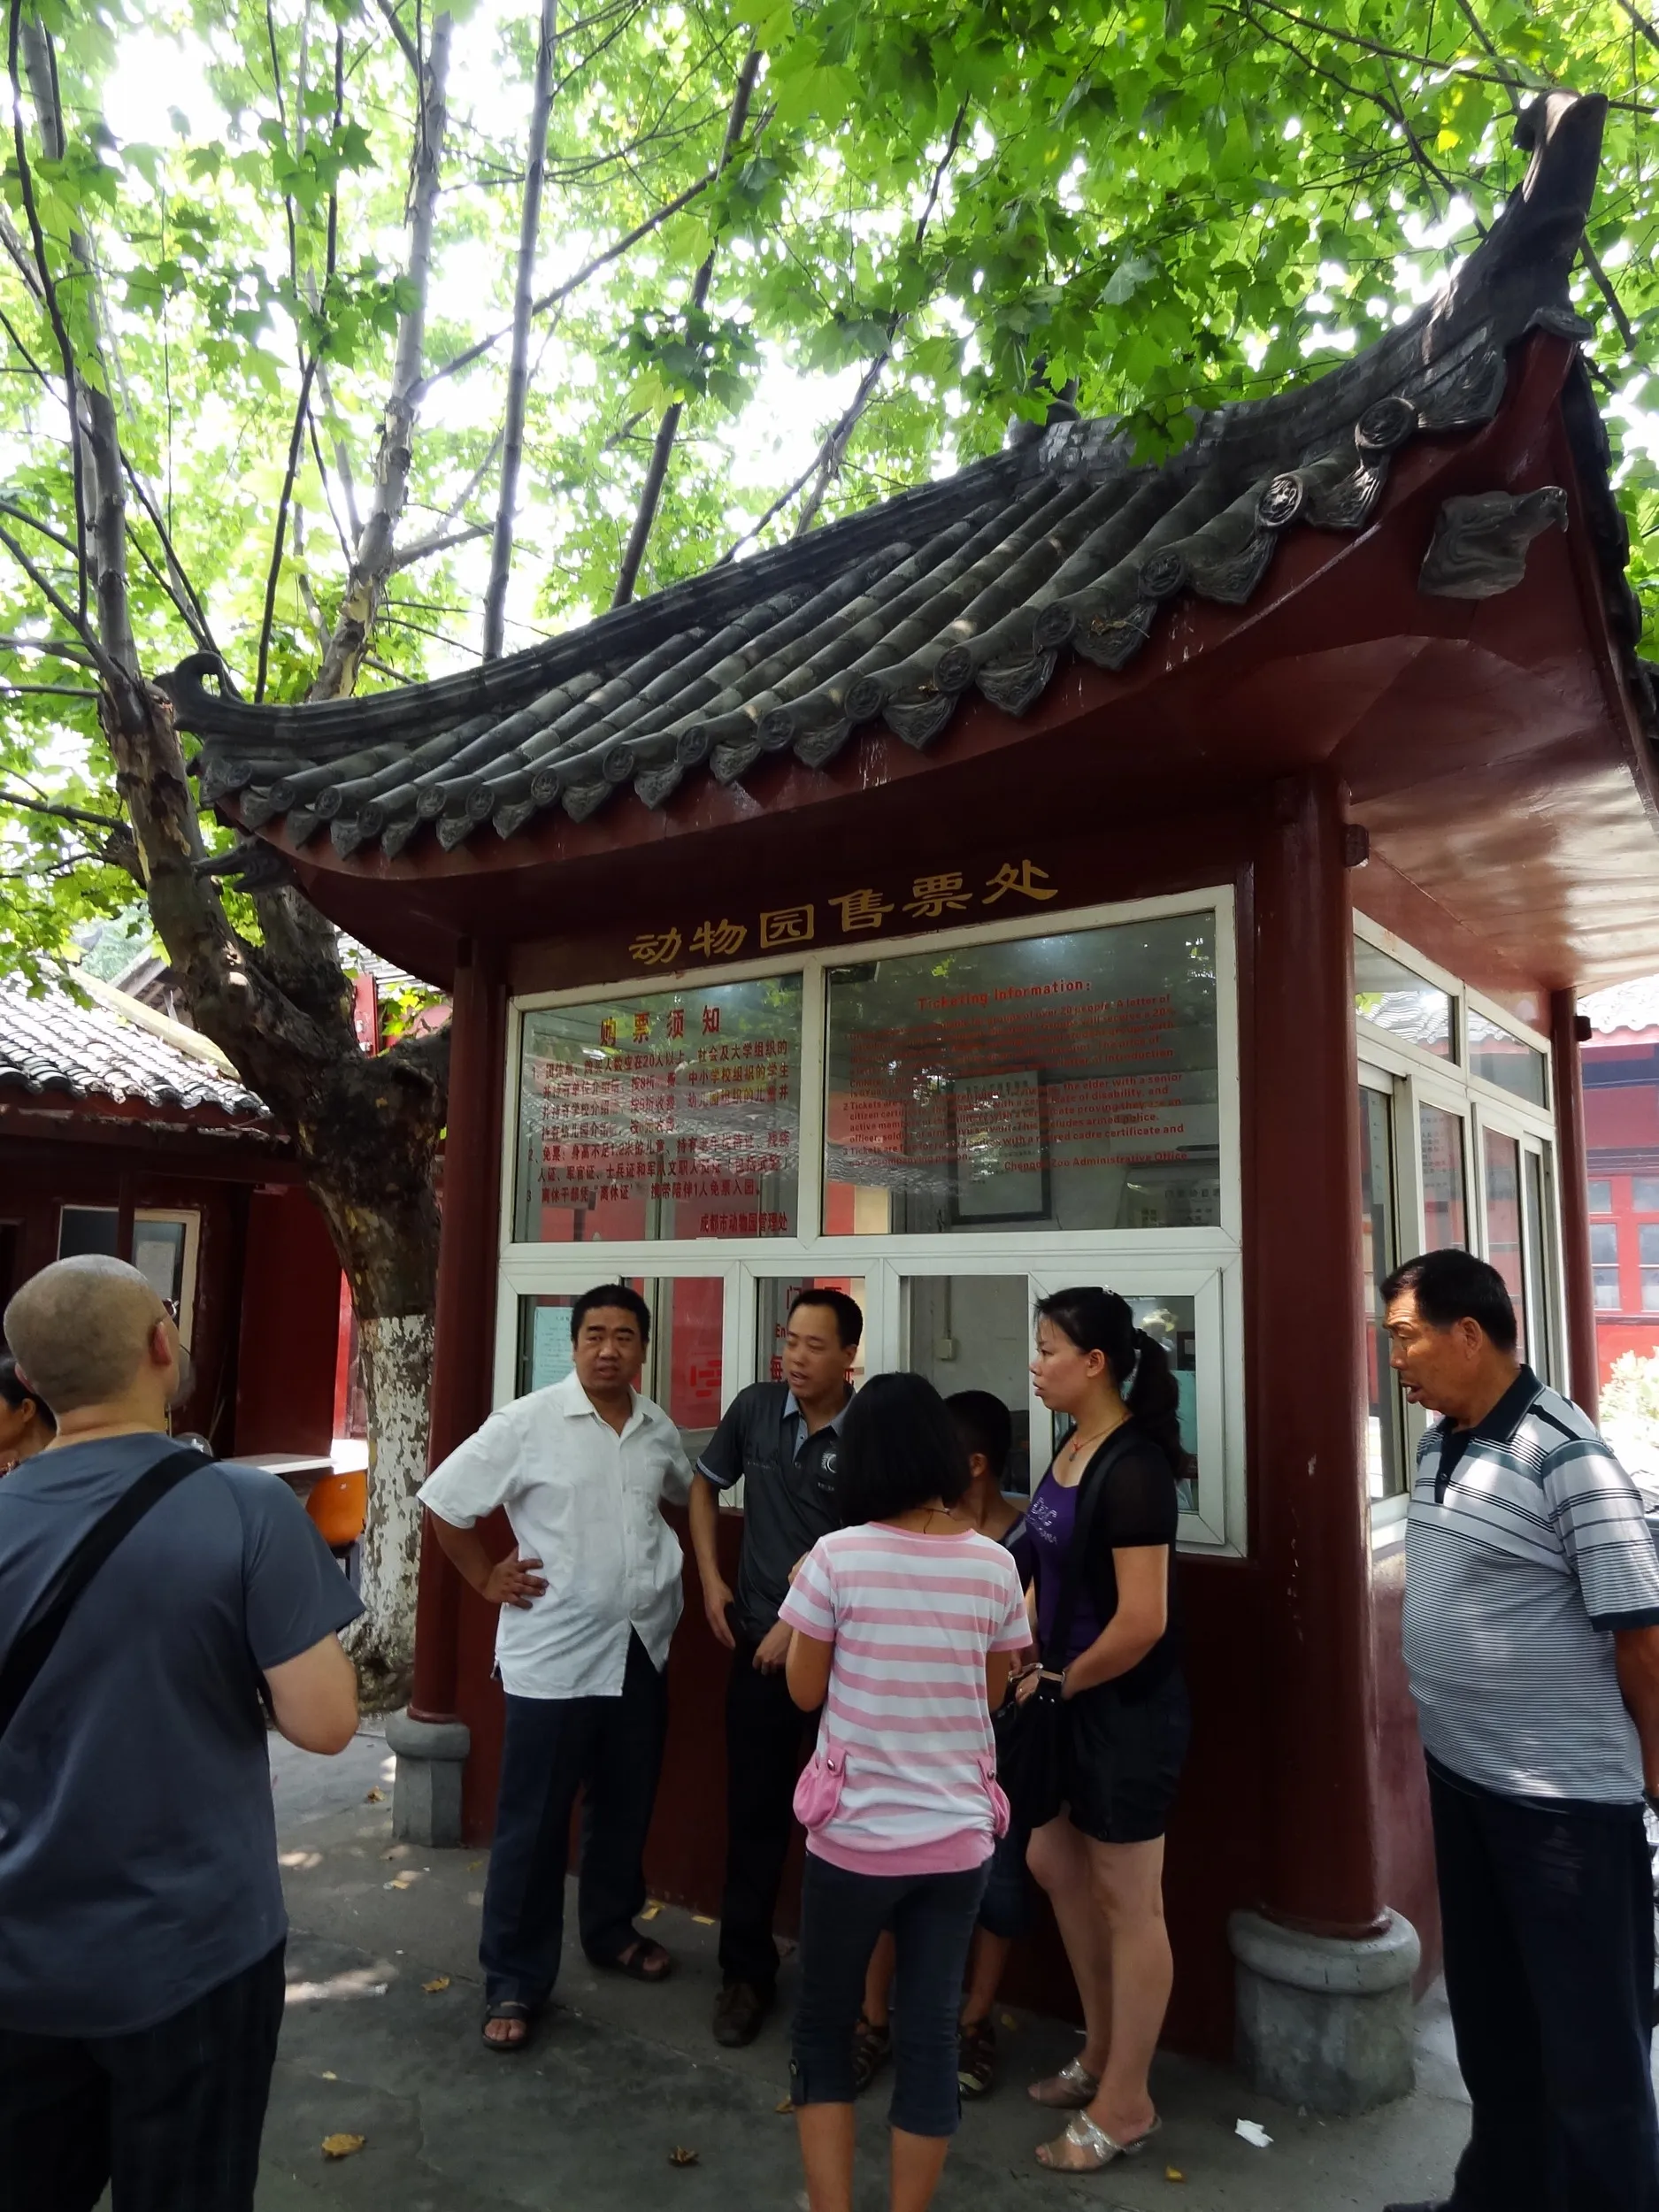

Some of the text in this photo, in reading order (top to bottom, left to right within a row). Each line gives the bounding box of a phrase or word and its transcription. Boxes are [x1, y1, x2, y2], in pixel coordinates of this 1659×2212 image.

[629, 860, 1059, 964] 动物园售票处
[918, 979, 1090, 1011] Ticketing Information:
[1116, 998, 1123, 1008] A
[1126, 995, 1155, 1006] letter
[1159, 993, 1170, 1002] of
[600, 1005, 721, 1046] 购票须知
[1105, 1047, 1174, 1062] introduction
[849, 1111, 879, 1122] citizen
[1079, 1092, 1088, 1101] of
[1148, 1084, 1169, 1094] and
[850, 1100, 881, 1111] Tickets
[1064, 1082, 1080, 1092] the
[1083, 1079, 1109, 1090] elder
[1112, 1077, 1136, 1087] with
[1148, 1073, 1182, 1085] senior
[849, 1123, 875, 1133] active
[1077, 1102, 1118, 1116] proving
[882, 1132, 912, 1141] solder
[1040, 1118, 1083, 1130] cludes
[1086, 1116, 1119, 1126] armed
[1122, 1113, 1158, 1125] police.
[842, 1149, 848, 1158] 3
[1002, 1135, 1025, 1146] with
[1072, 1130, 1102, 1141] cadre
[1103, 1125, 1161, 1138] certificate
[1163, 1124, 1183, 1133] and
[936, 1154, 972, 1165] peron.
[1072, 1152, 1151, 1167] Administrative
[1155, 1150, 1187, 1162] Office
[700, 1211, 787, 1233] 成都市动物园管理处
